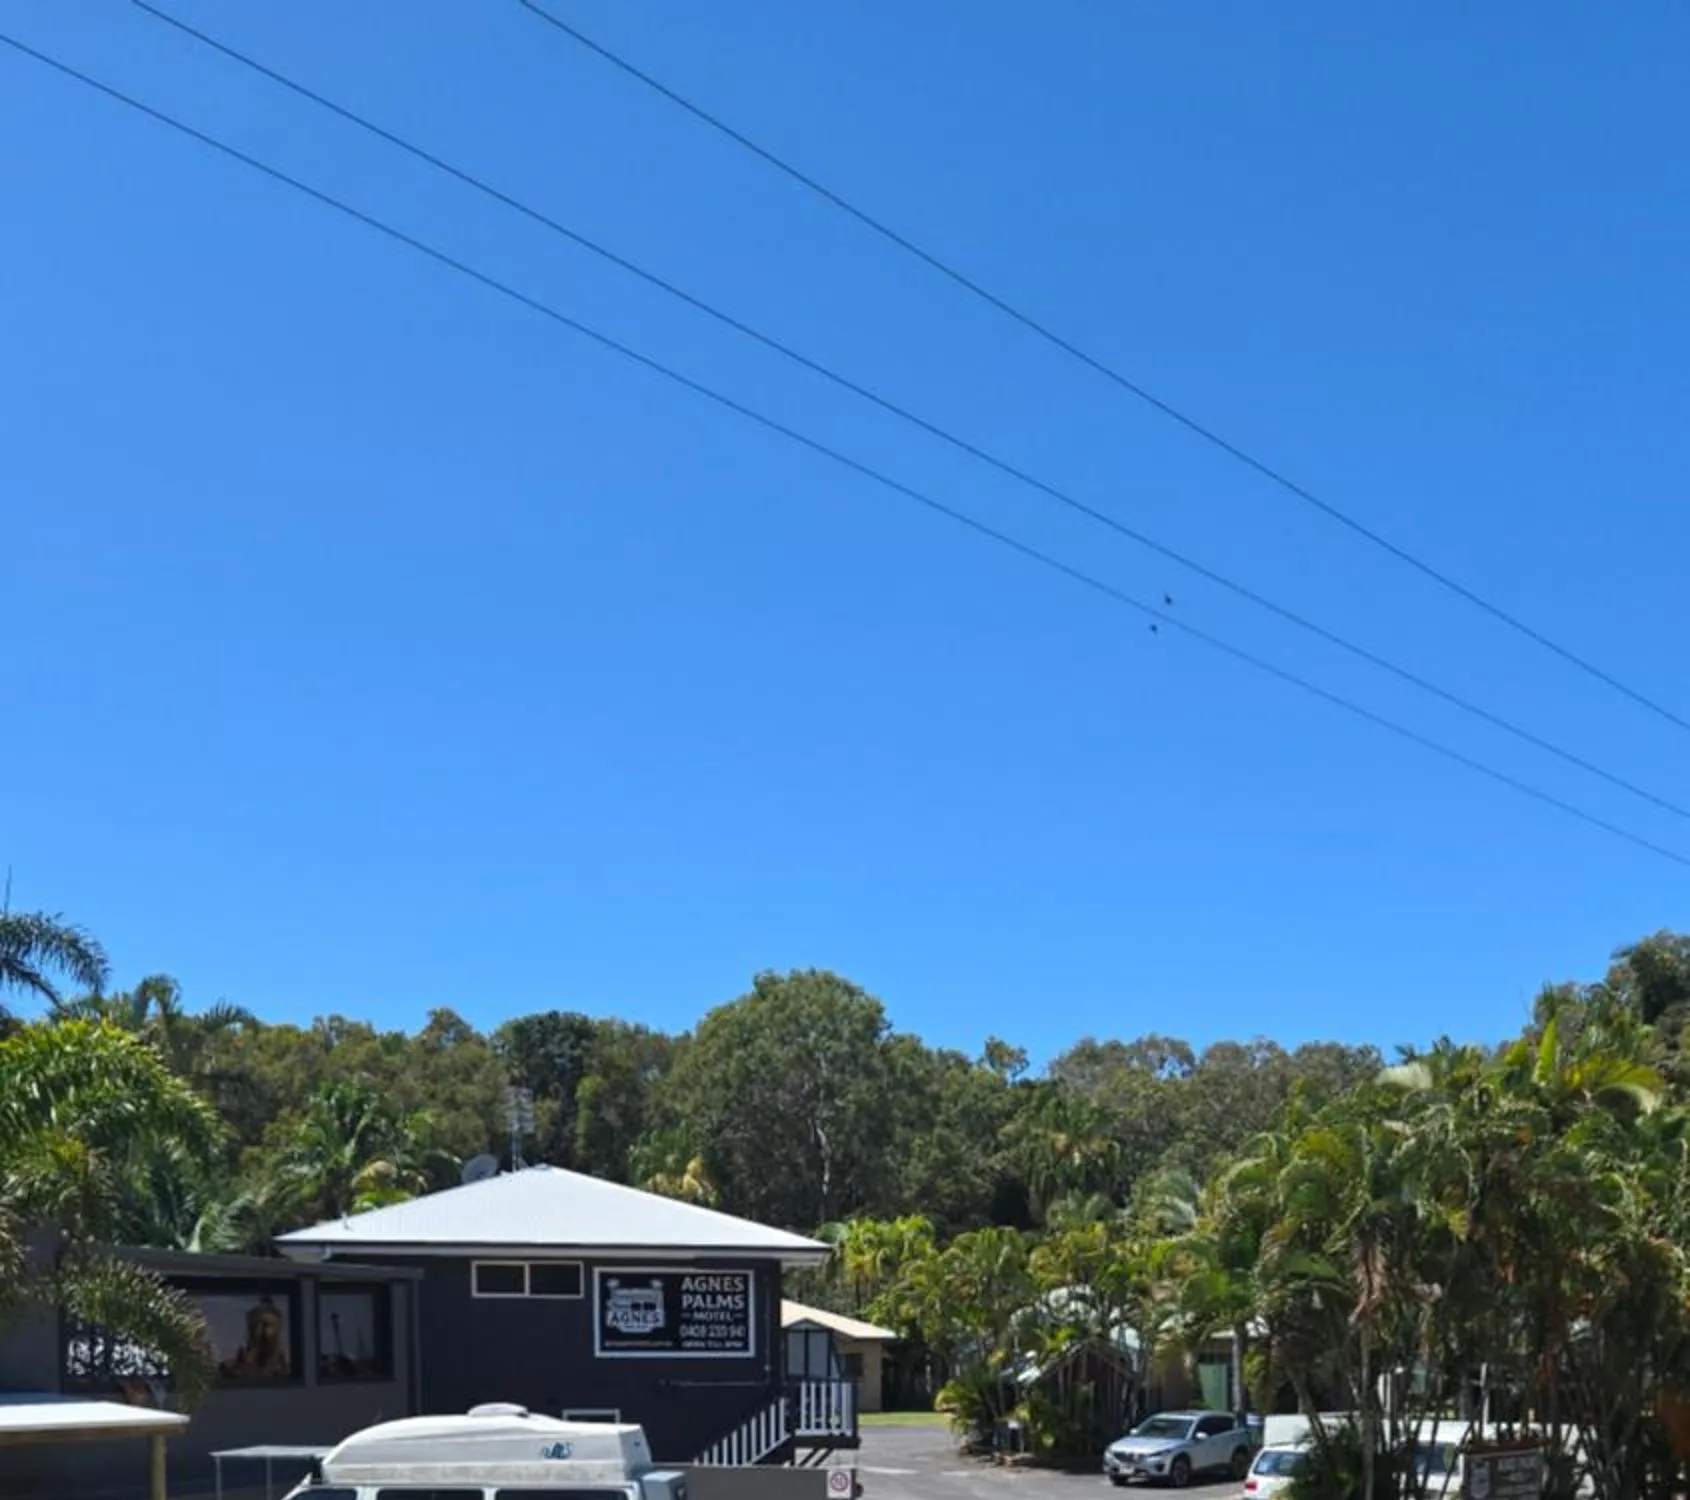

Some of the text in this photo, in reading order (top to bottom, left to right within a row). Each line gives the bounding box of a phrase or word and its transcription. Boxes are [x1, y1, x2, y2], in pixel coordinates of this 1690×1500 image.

[682, 1276, 744, 1291] AGNES
[682, 1294, 744, 1309] PALMS
[610, 1311, 661, 1324] AGNES
[693, 1311, 733, 1321] MOTEL
